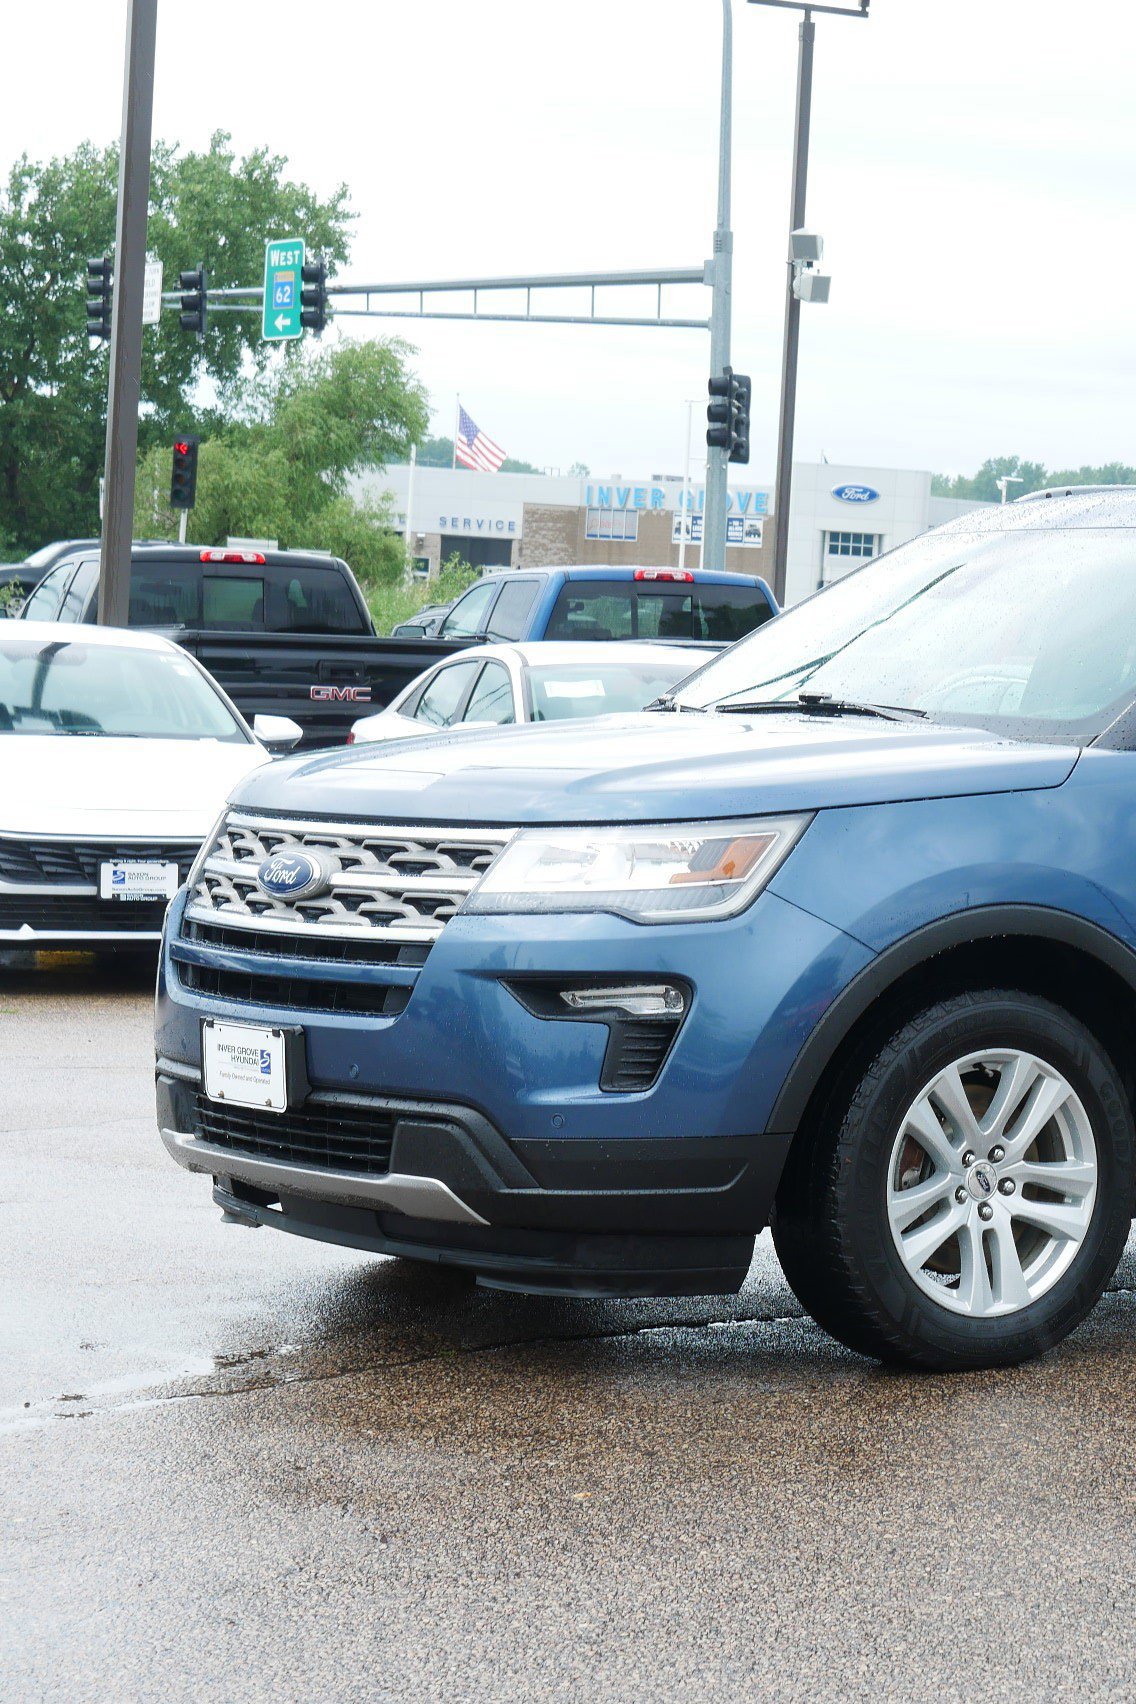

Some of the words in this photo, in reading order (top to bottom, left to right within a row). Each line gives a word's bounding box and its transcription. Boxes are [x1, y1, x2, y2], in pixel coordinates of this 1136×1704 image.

[270, 250, 300, 267] WEST
[275, 285, 291, 304] 62
[585, 485, 665, 509] INVER
[679, 488, 769, 514] GVE
[439, 516, 516, 532] SERVICE
[310, 685, 372, 701] GMC
[263, 857, 301, 885] Ford
[217, 1044, 236, 1054] INVER
[237, 1046, 259, 1057] GROVE
